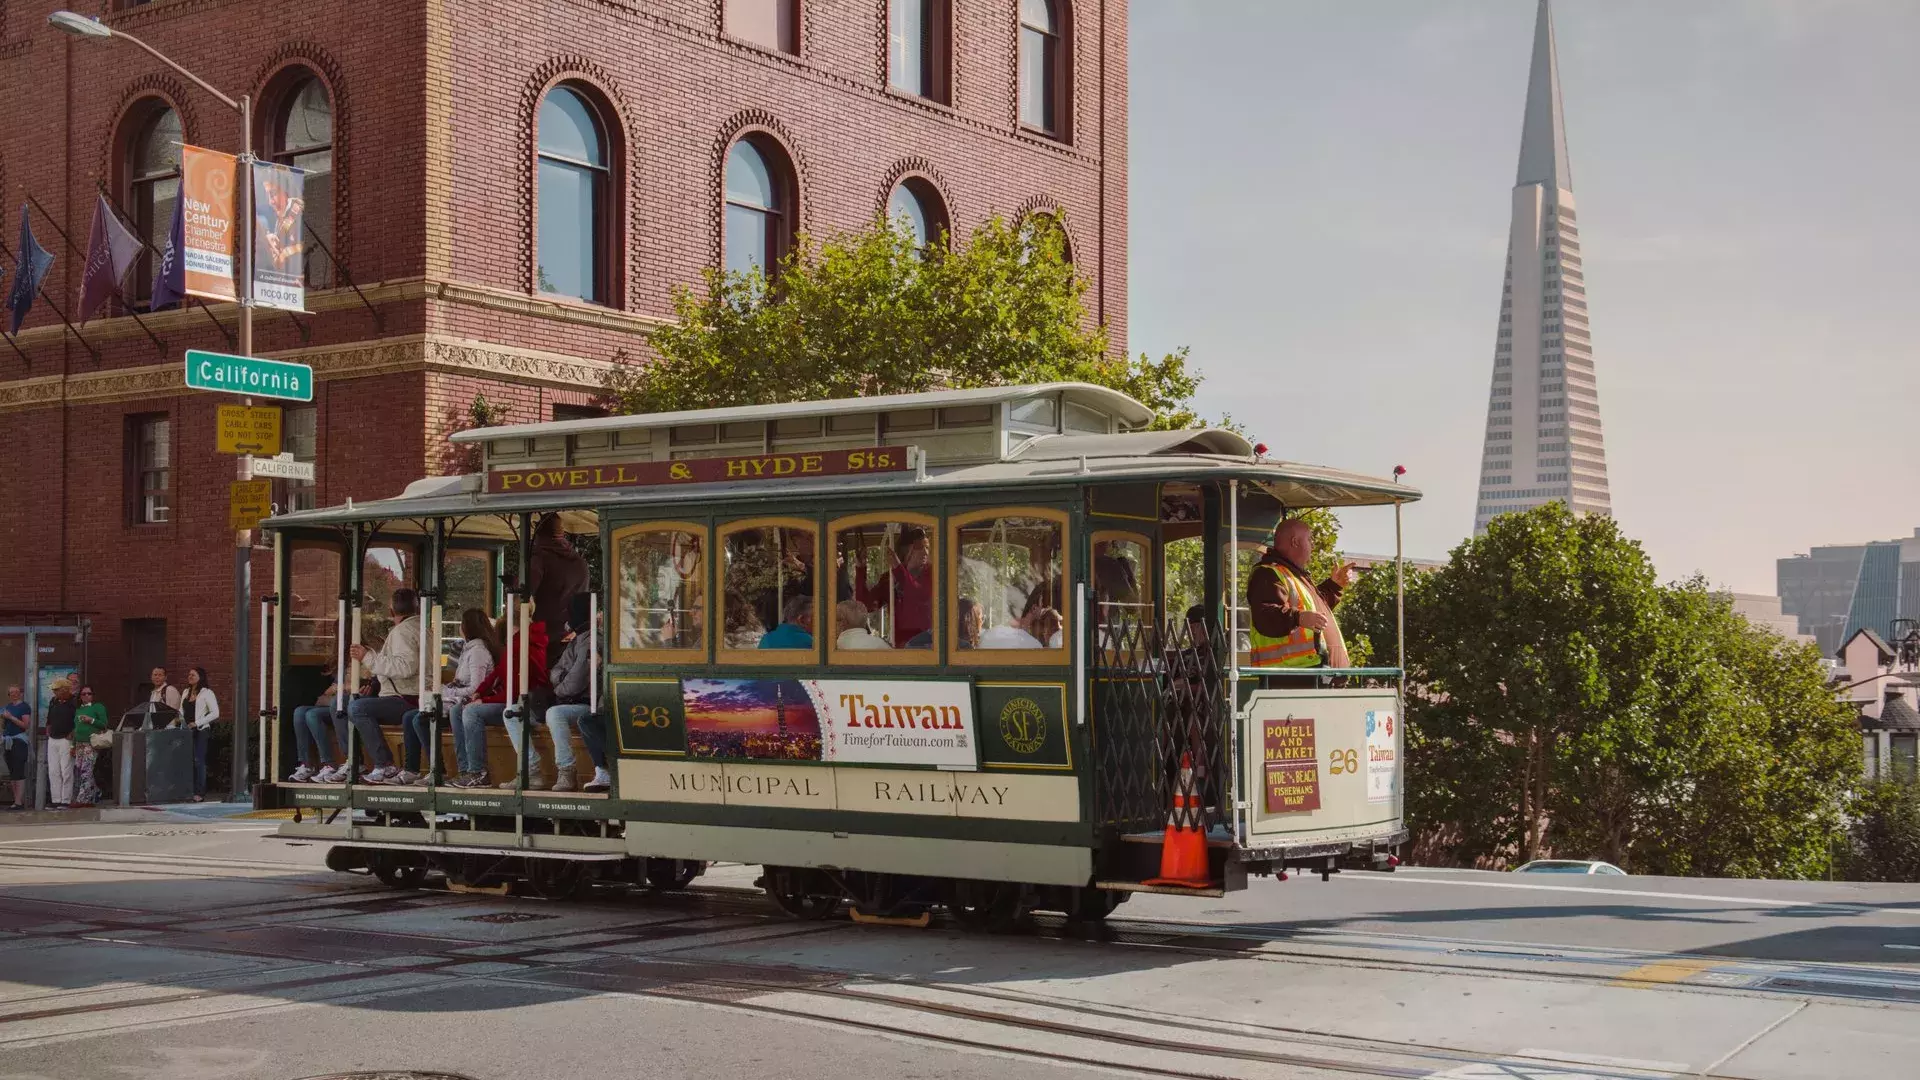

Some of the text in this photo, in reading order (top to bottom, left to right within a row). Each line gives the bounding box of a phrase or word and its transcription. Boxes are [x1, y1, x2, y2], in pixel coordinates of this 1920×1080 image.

[184, 197, 211, 213] New
[184, 210, 229, 232] Century
[185, 224, 224, 239] Chamber
[185, 236, 226, 251] Orchestra
[205, 255, 230, 266] SALERNO
[260, 288, 298, 304] ncco.org
[200, 361, 299, 391] California
[222, 410, 277, 419] CROSS STREET
[225, 421, 248, 429] CABLE
[224, 430, 274, 440] DO NOT STOP
[255, 462, 310, 476] CALIFORNIA
[501, 451, 897, 490] POWELL & HYDE Sts.
[631, 705, 671, 728] 26
[839, 693, 964, 730] Taiwan
[1001, 699, 1043, 720] MUNICIPAL
[1266, 725, 1313, 738] POWELL
[843, 733, 954, 748] TimeforTaiwan.com
[1003, 732, 1043, 753] RAILWAY
[1280, 737, 1303, 746] AND
[1265, 747, 1314, 760] MARKET
[1368, 744, 1394, 762] Taiwan
[1329, 748, 1358, 775] 26
[1269, 773, 1287, 785] HYDE
[1295, 770, 1317, 784] BEACH
[669, 773, 1008, 805] MUNICIPAL RAILWAY
[1273, 785, 1314, 797] FISHERMANS
[1283, 795, 1305, 806] WHARF
